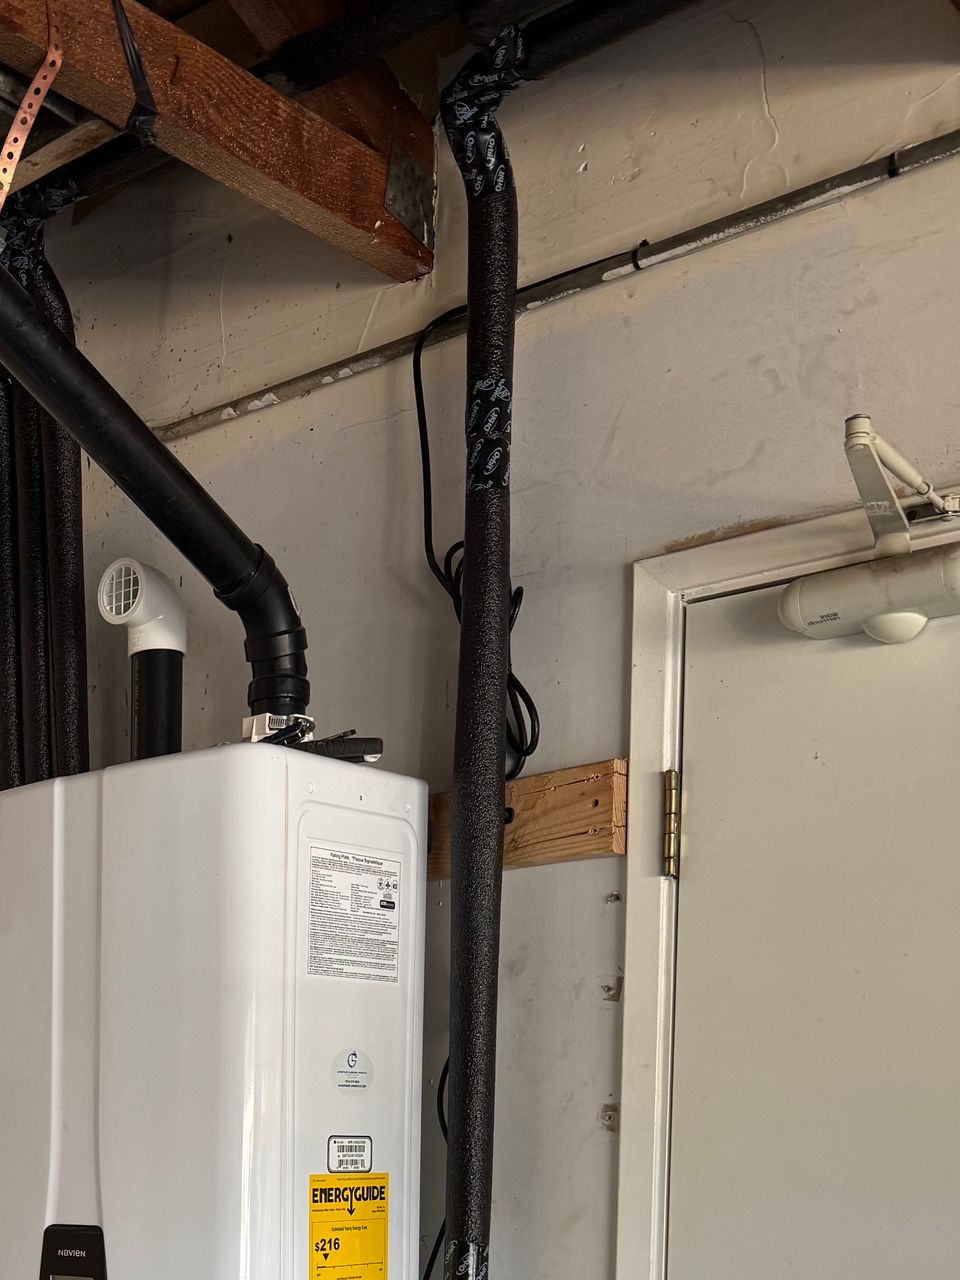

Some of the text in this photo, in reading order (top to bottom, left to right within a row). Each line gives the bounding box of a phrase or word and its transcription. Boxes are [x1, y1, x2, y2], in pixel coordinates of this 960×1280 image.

[495, 168, 506, 192] Orbit
[483, 411, 499, 433] Orbit
[485, 451, 501, 472] Orbit
[312, 1185, 386, 1205] ENERGYGUIDE
[314, 1237, 340, 1252] $216
